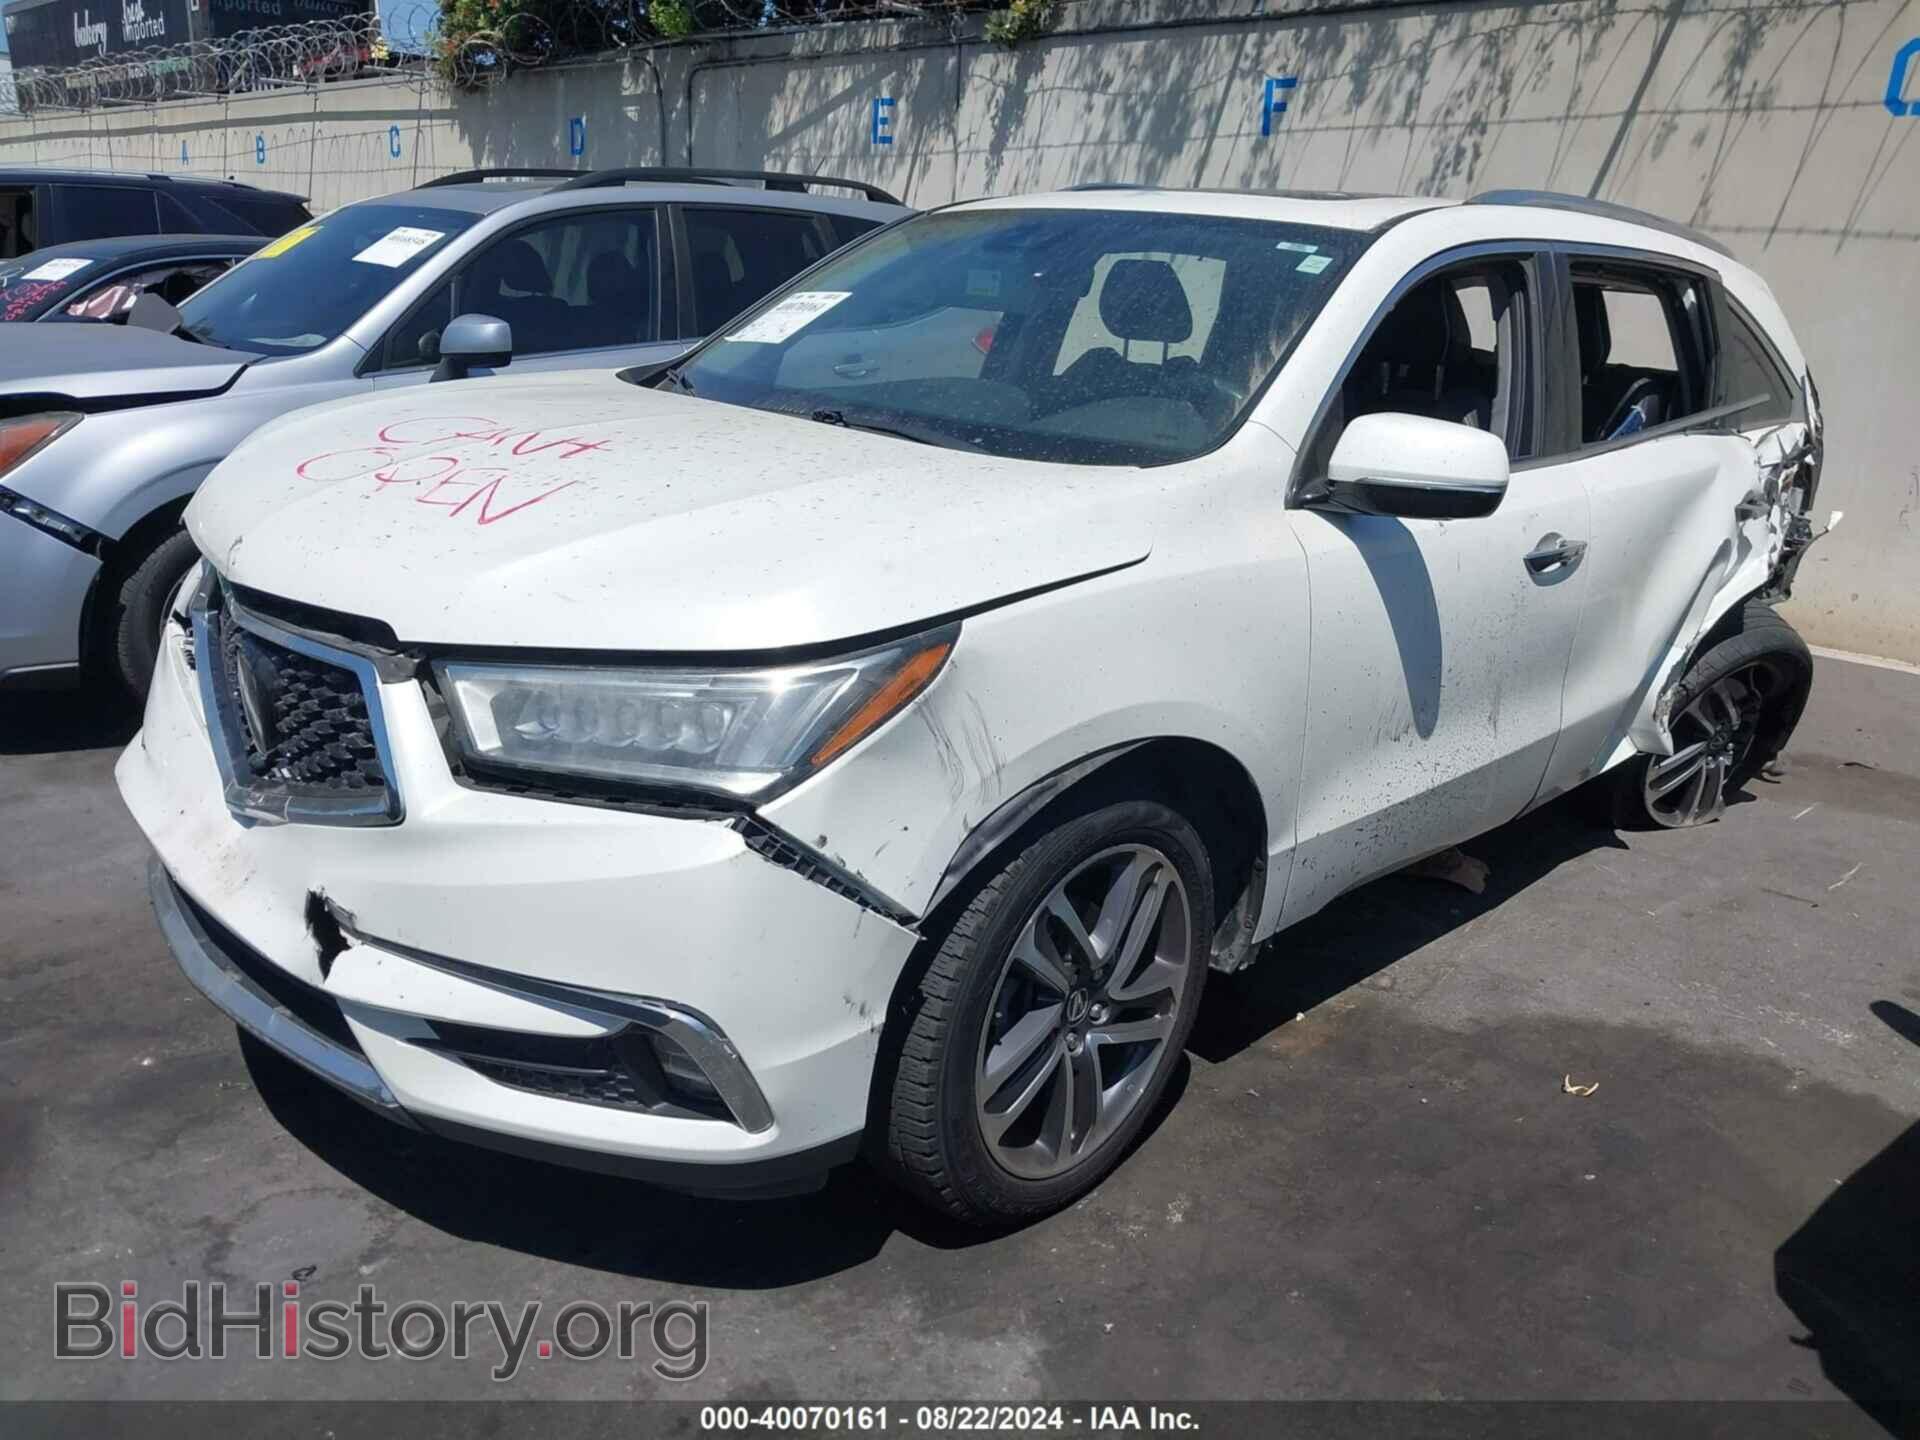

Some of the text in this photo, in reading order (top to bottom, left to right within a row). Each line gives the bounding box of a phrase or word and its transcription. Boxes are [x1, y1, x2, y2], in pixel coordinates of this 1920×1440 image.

[74, 9, 107, 55] bakery
[122, 11, 165, 44] imported
[871, 98, 896, 144] E
[1262, 78, 1297, 136] F
[181, 139, 189, 165] A
[255, 135, 266, 164] B
[390, 126, 401, 157] C
[571, 118, 585, 156] D
